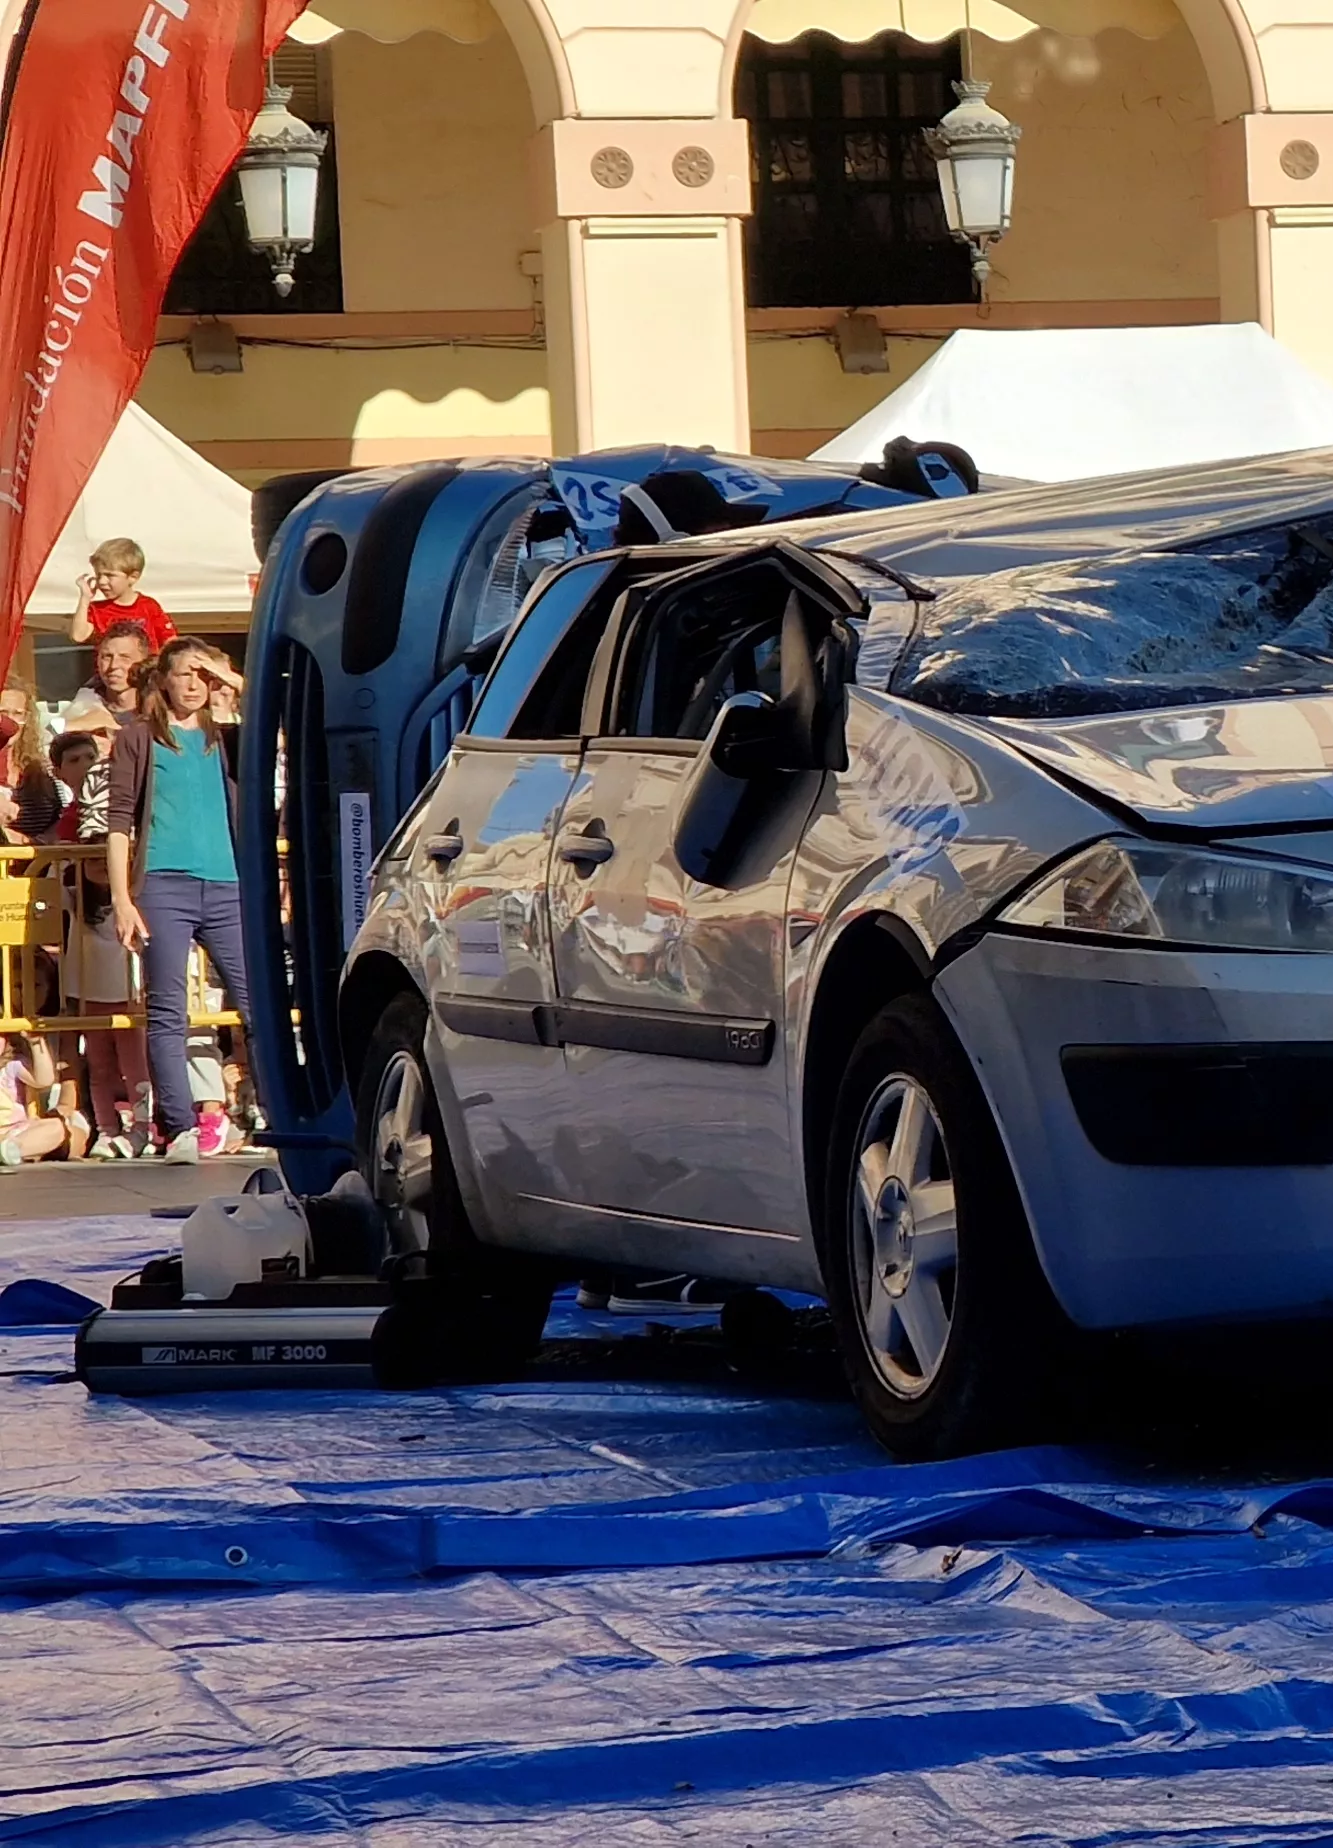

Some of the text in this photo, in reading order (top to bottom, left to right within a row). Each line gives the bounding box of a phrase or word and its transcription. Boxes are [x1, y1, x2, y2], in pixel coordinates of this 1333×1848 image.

[77, 0, 190, 229] MAPF
[179, 1348, 236, 1361] MARK
[281, 1345, 327, 1361] 3000
